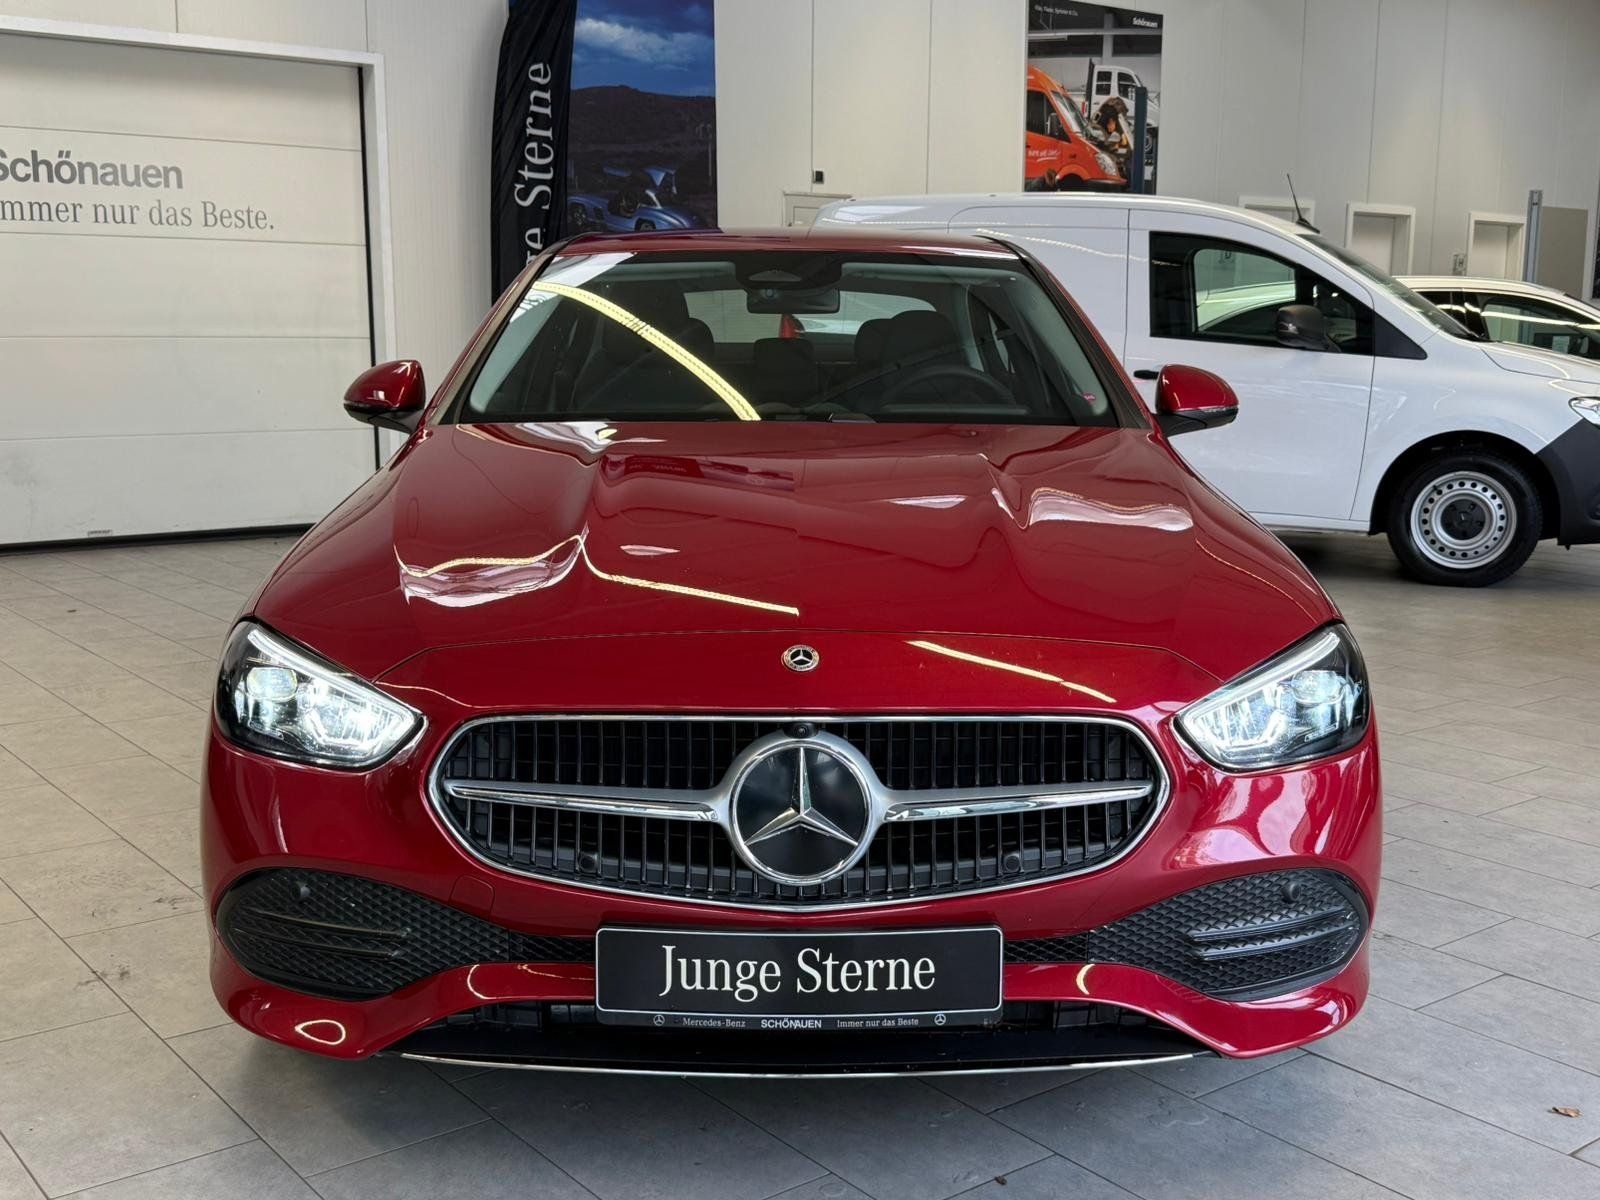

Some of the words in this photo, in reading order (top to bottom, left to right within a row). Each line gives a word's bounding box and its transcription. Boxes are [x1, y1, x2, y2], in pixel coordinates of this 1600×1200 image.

[514, 62, 554, 210] Sterne
[93, 202, 140, 225] nur
[148, 199, 193, 227] das
[200, 200, 275, 230] Beste.
[658, 945, 781, 1003] Junge
[796, 947, 936, 993] Sterne
[682, 1017, 746, 1028] Mercedes-Benz
[760, 1017, 822, 1029] SCHÖNAUEN
[837, 1019, 864, 1028] Immer
[865, 1020, 879, 1028] nur
[881, 1019, 896, 1027] das
[897, 1018, 919, 1027] Beste
